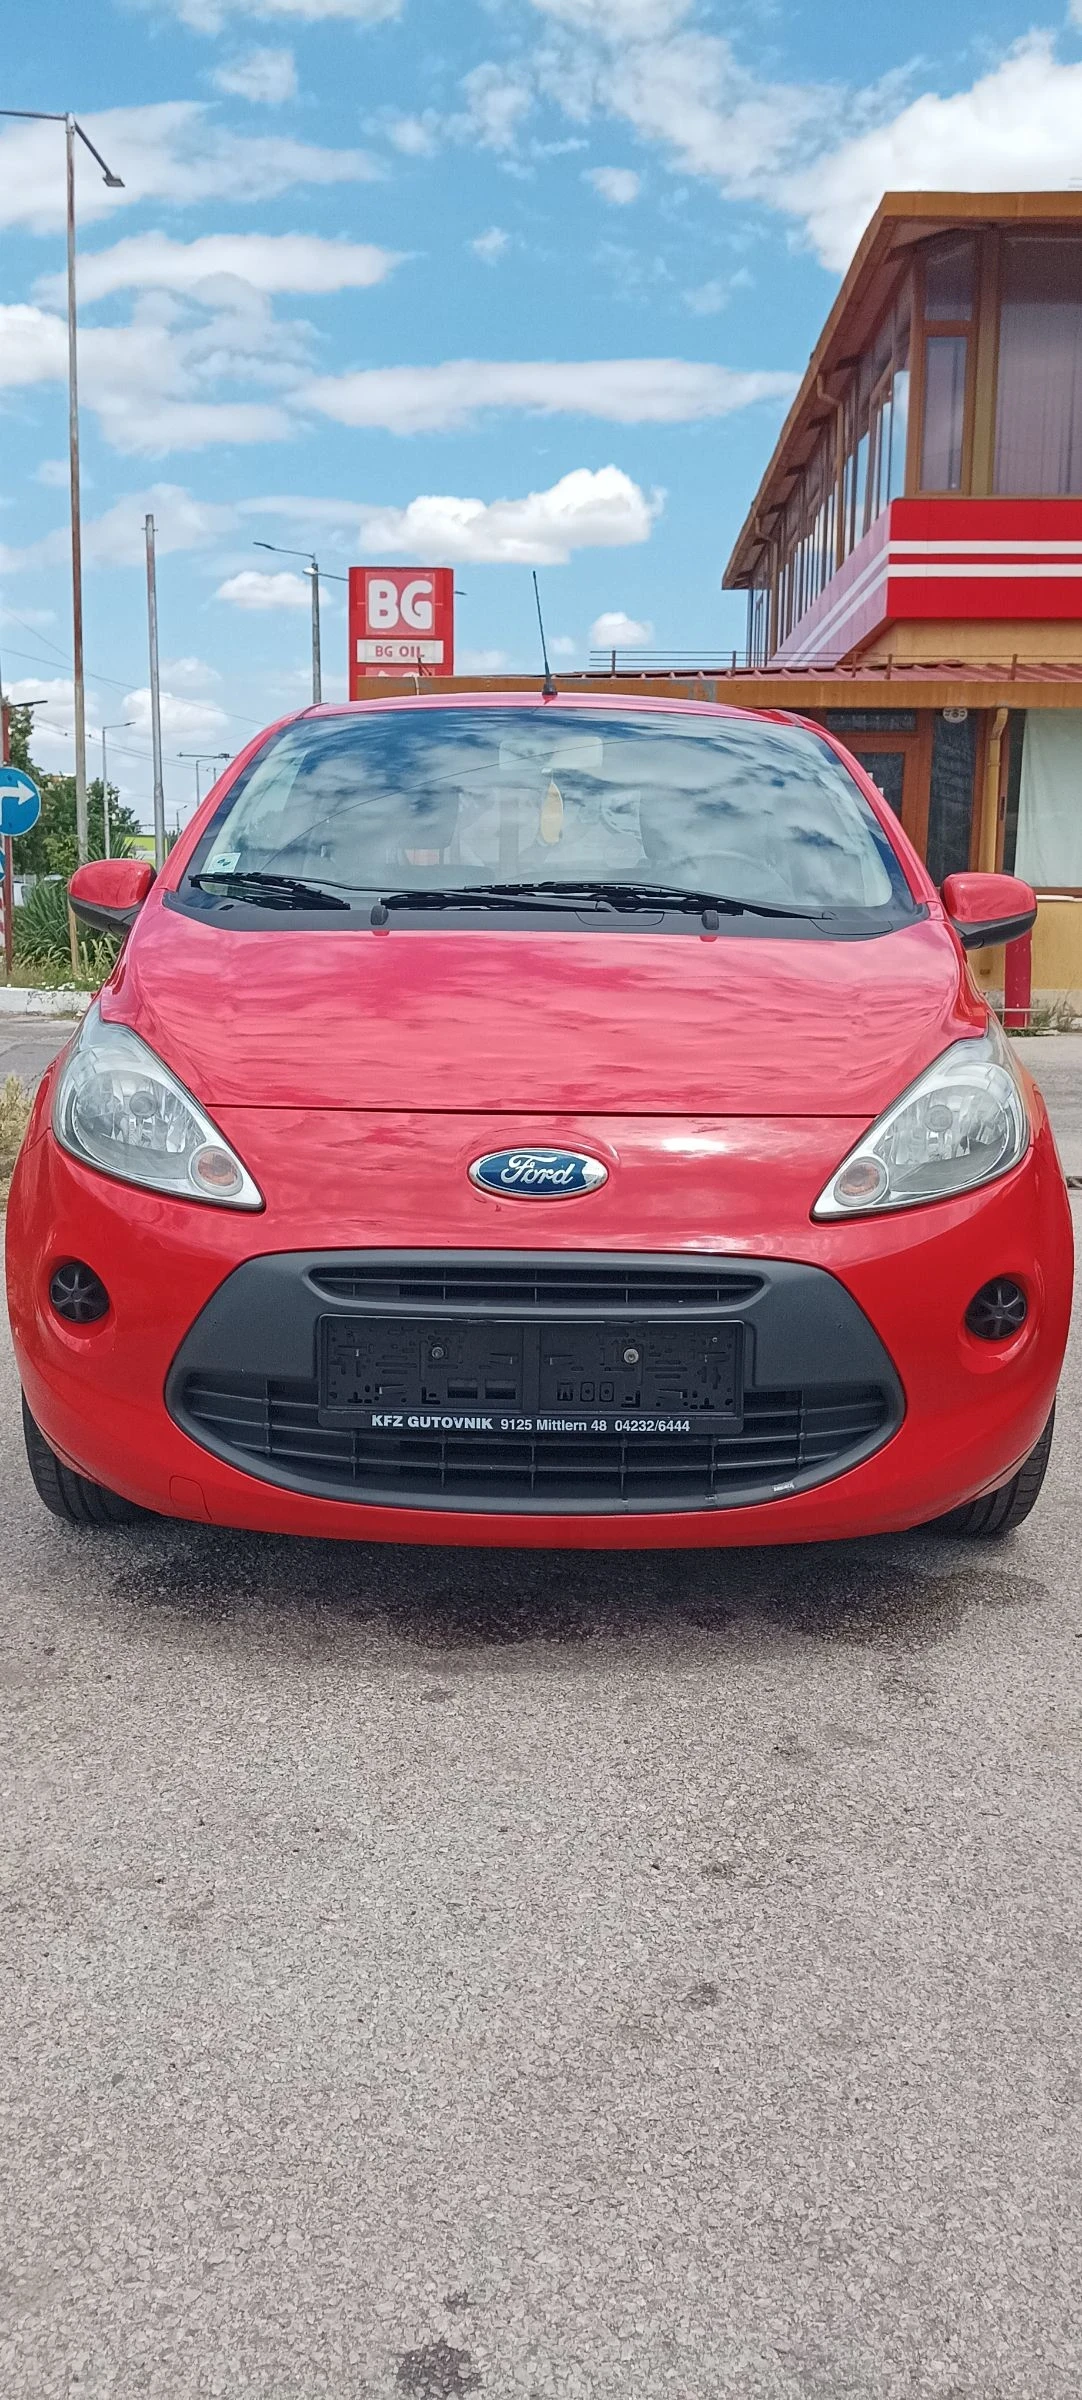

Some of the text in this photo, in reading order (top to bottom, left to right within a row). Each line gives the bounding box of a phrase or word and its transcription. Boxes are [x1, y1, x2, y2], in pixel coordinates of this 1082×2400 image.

[368, 579, 433, 630] BG
[375, 645, 425, 658] BG OIL
[500, 1154, 576, 1185] Ford
[371, 1414, 690, 1432] KFZ GUTOVNIK 9125 Mittlern 48 04232/6444
